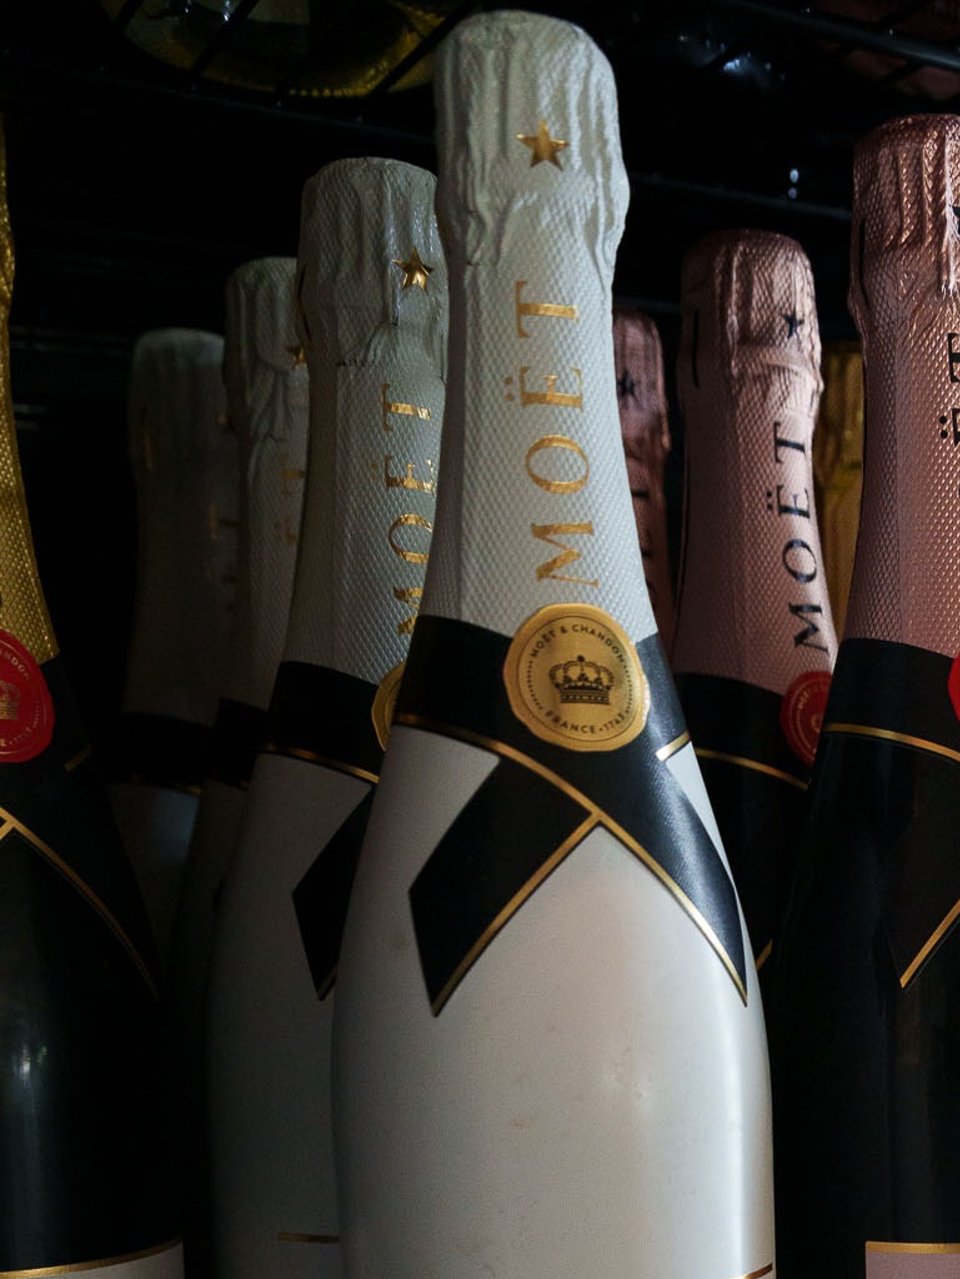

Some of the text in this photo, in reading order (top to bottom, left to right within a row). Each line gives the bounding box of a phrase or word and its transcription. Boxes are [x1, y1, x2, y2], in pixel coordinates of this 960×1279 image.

[505, 281, 598, 587] MOËT
[767, 423, 829, 654] MOËT
[572, 624, 624, 664] CHANDON
